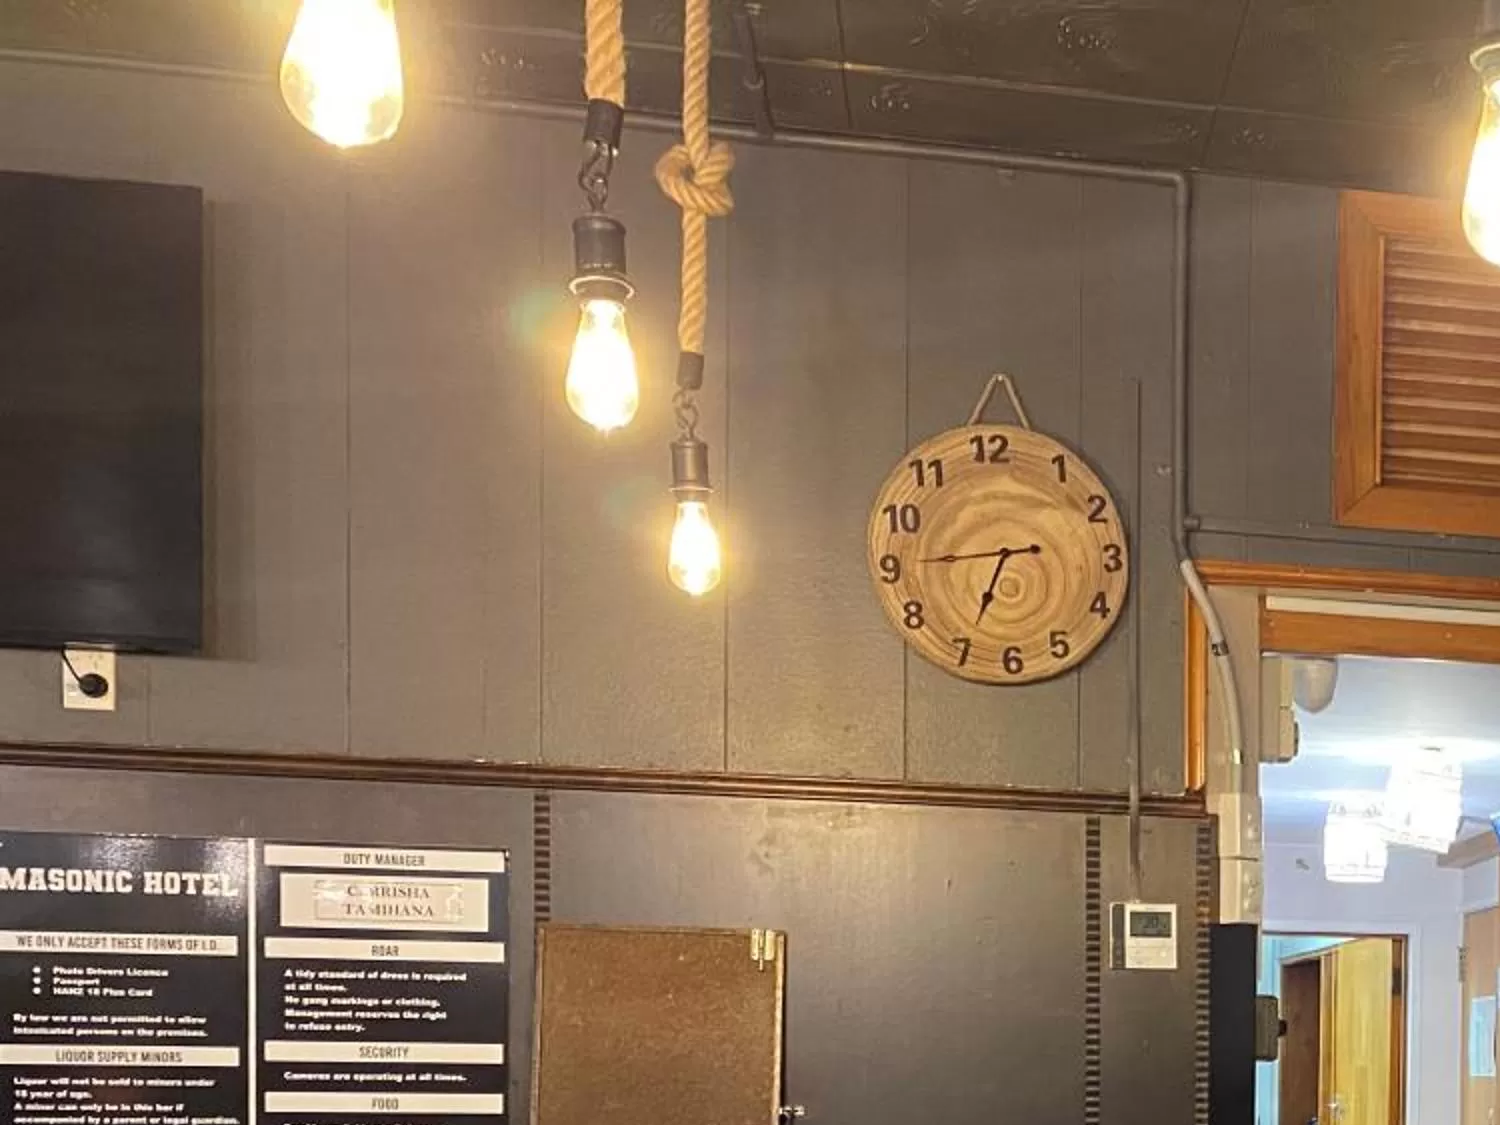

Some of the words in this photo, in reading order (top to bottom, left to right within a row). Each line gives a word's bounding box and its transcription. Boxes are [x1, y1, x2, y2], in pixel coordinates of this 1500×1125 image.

[969, 435, 1010, 463] 12
[909, 459, 943, 488] 11
[1051, 454, 1067, 483] 1
[883, 504, 921, 533] 10
[1087, 495, 1108, 524] 2
[879, 554, 900, 583] 9
[1103, 544, 1123, 573] 3
[903, 601, 925, 629] 8
[1089, 591, 1111, 619] 4
[952, 637, 972, 667] 7
[1050, 631, 1070, 659] 5
[1002, 646, 1024, 674] 6
[344, 853, 372, 865] DUTY
[374, 853, 425, 866] MANAGER
[0, 867, 133, 894] MASONIC
[143, 871, 239, 897] HOTEL
[16, 936, 32, 947] WE
[36, 936, 64, 948] ONLY
[67, 936, 107, 949] ACCEPT
[111, 937, 144, 949] THESE
[147, 938, 183, 950] FORMS
[185, 938, 199, 950] OF
[318, 970, 365, 979] standard
[367, 971, 379, 979] of
[56, 1050, 94, 1062] LIQUOR
[97, 1050, 137, 1063] SUPPLY
[141, 1051, 183, 1063] MINORS
[359, 1047, 410, 1058] SECURITY
